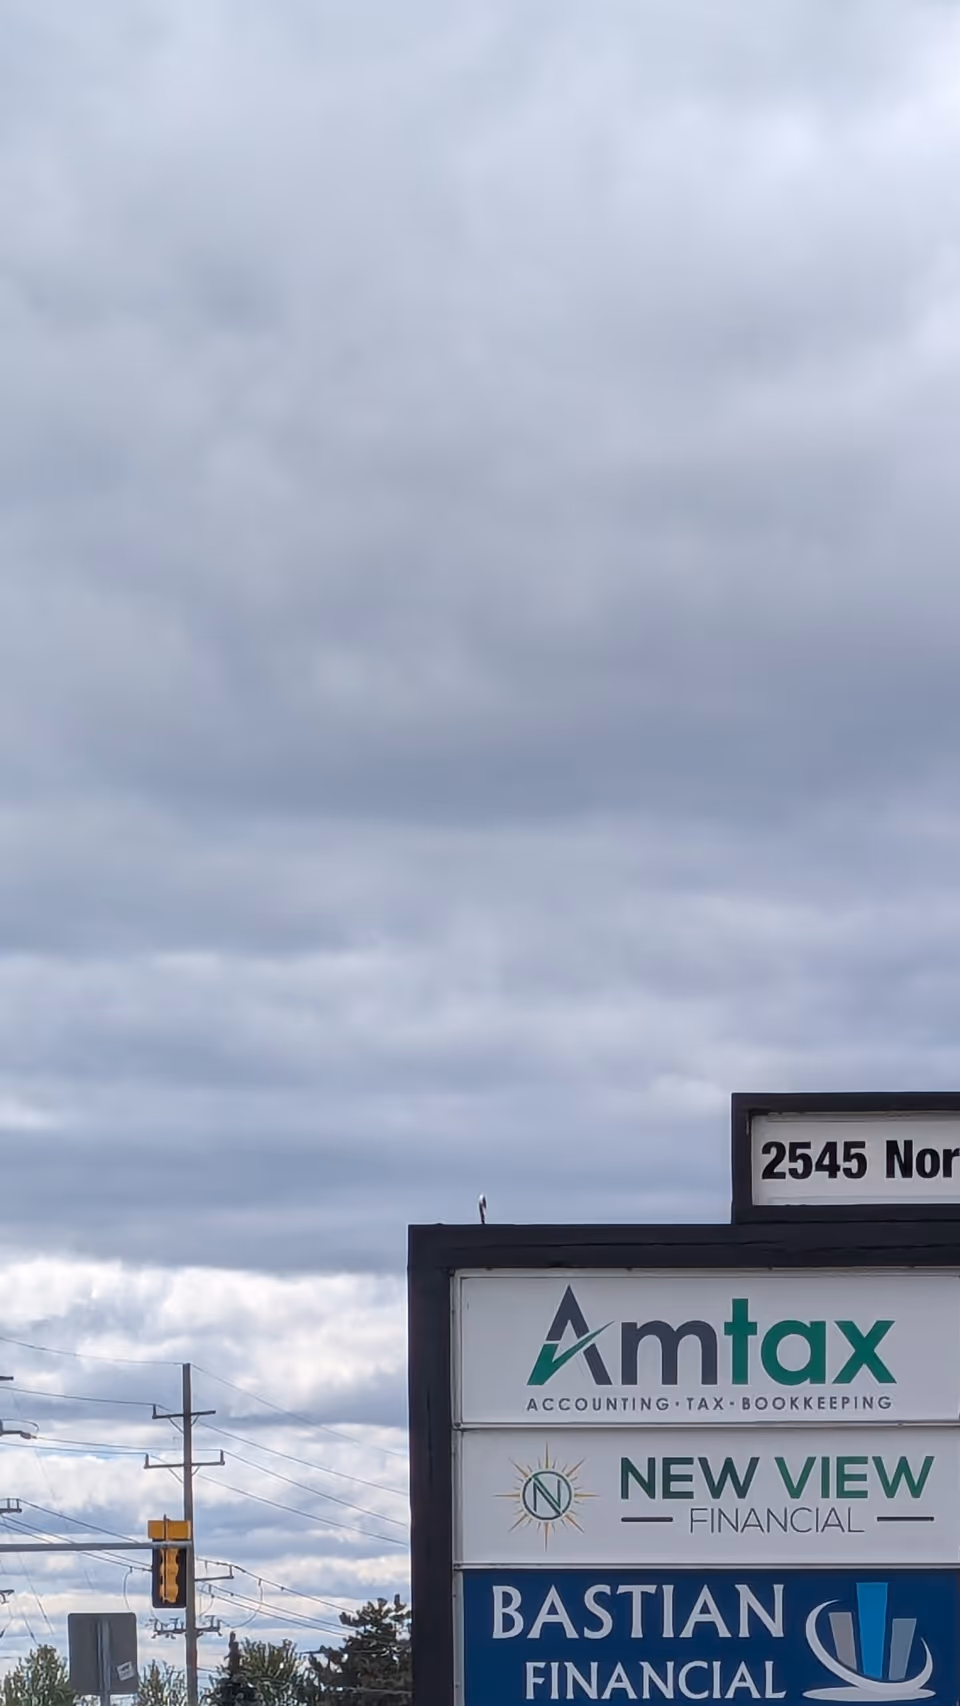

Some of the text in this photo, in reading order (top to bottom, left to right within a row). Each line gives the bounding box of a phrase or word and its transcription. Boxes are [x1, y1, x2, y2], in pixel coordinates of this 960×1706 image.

[762, 1141, 867, 1179] 2545
[527, 1285, 896, 1386] Amtax
[527, 1396, 891, 1411] ACCOUNTING TAX BOOKKEEPING
[621, 1456, 934, 1499] NEW VIEW
[691, 1507, 864, 1533] FINANCIAL
[493, 1584, 784, 1639] BASTIAN
[526, 1661, 786, 1699] FINANCIAL
